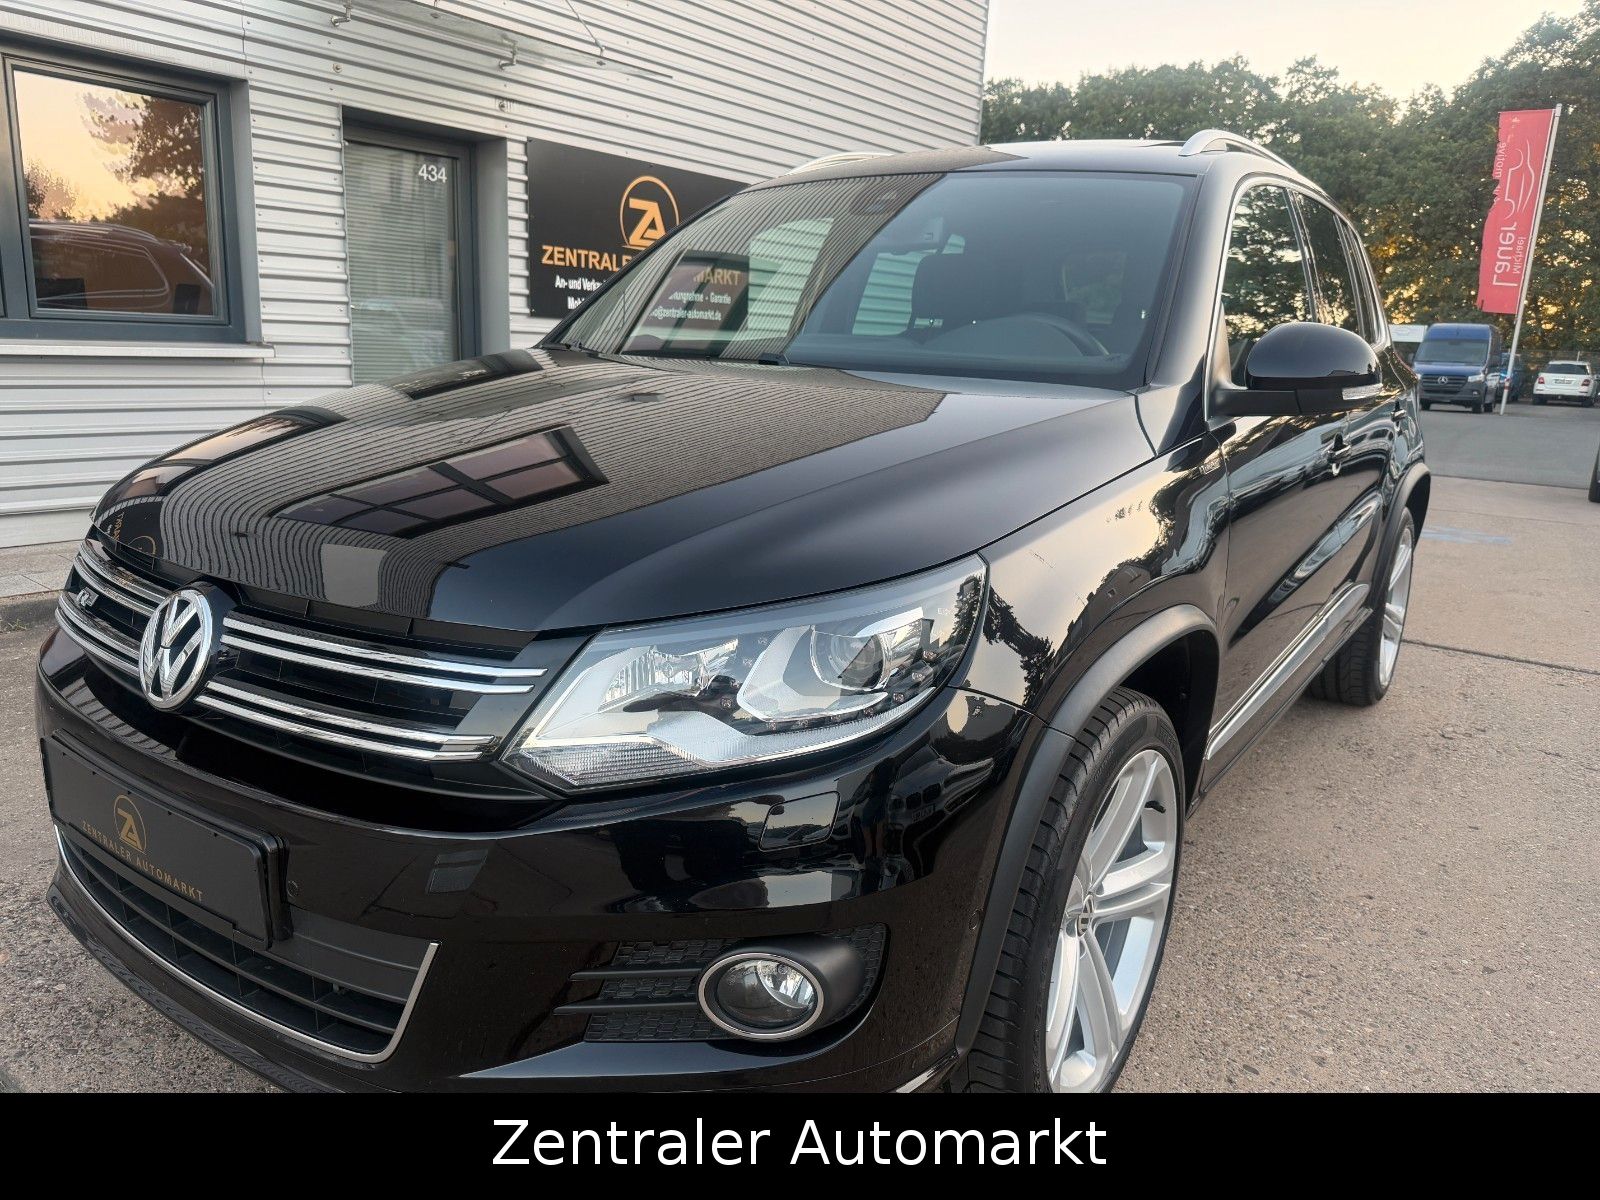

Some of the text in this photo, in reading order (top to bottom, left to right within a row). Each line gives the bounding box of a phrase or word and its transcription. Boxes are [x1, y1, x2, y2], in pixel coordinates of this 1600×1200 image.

[418, 163, 448, 183] 434
[541, 244, 633, 272] ZENTRALE
[568, 277, 582, 290] und
[82, 820, 203, 902] ZENTRALER AUTOMARKT
